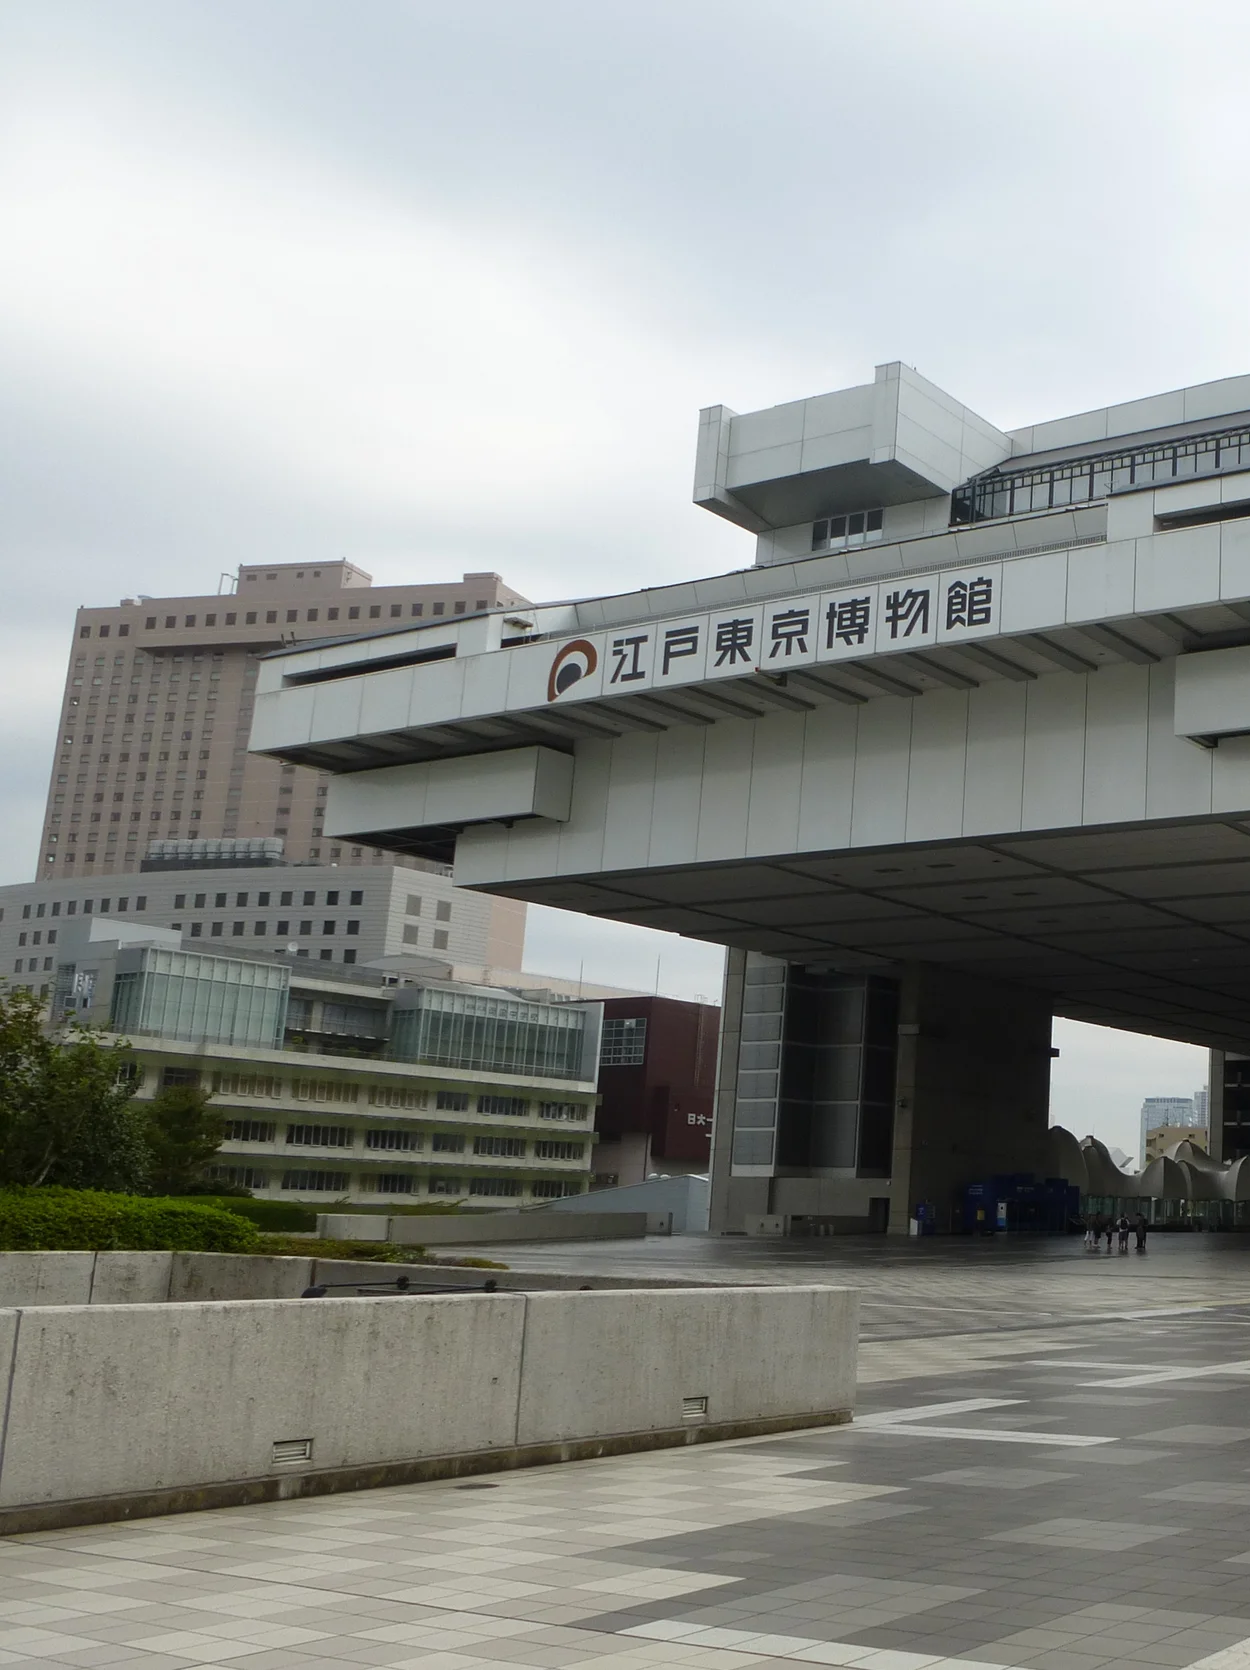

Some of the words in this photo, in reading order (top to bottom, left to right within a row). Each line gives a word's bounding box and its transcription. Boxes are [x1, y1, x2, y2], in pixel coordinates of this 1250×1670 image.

[610, 576, 993, 684] 江戸東京博物館
